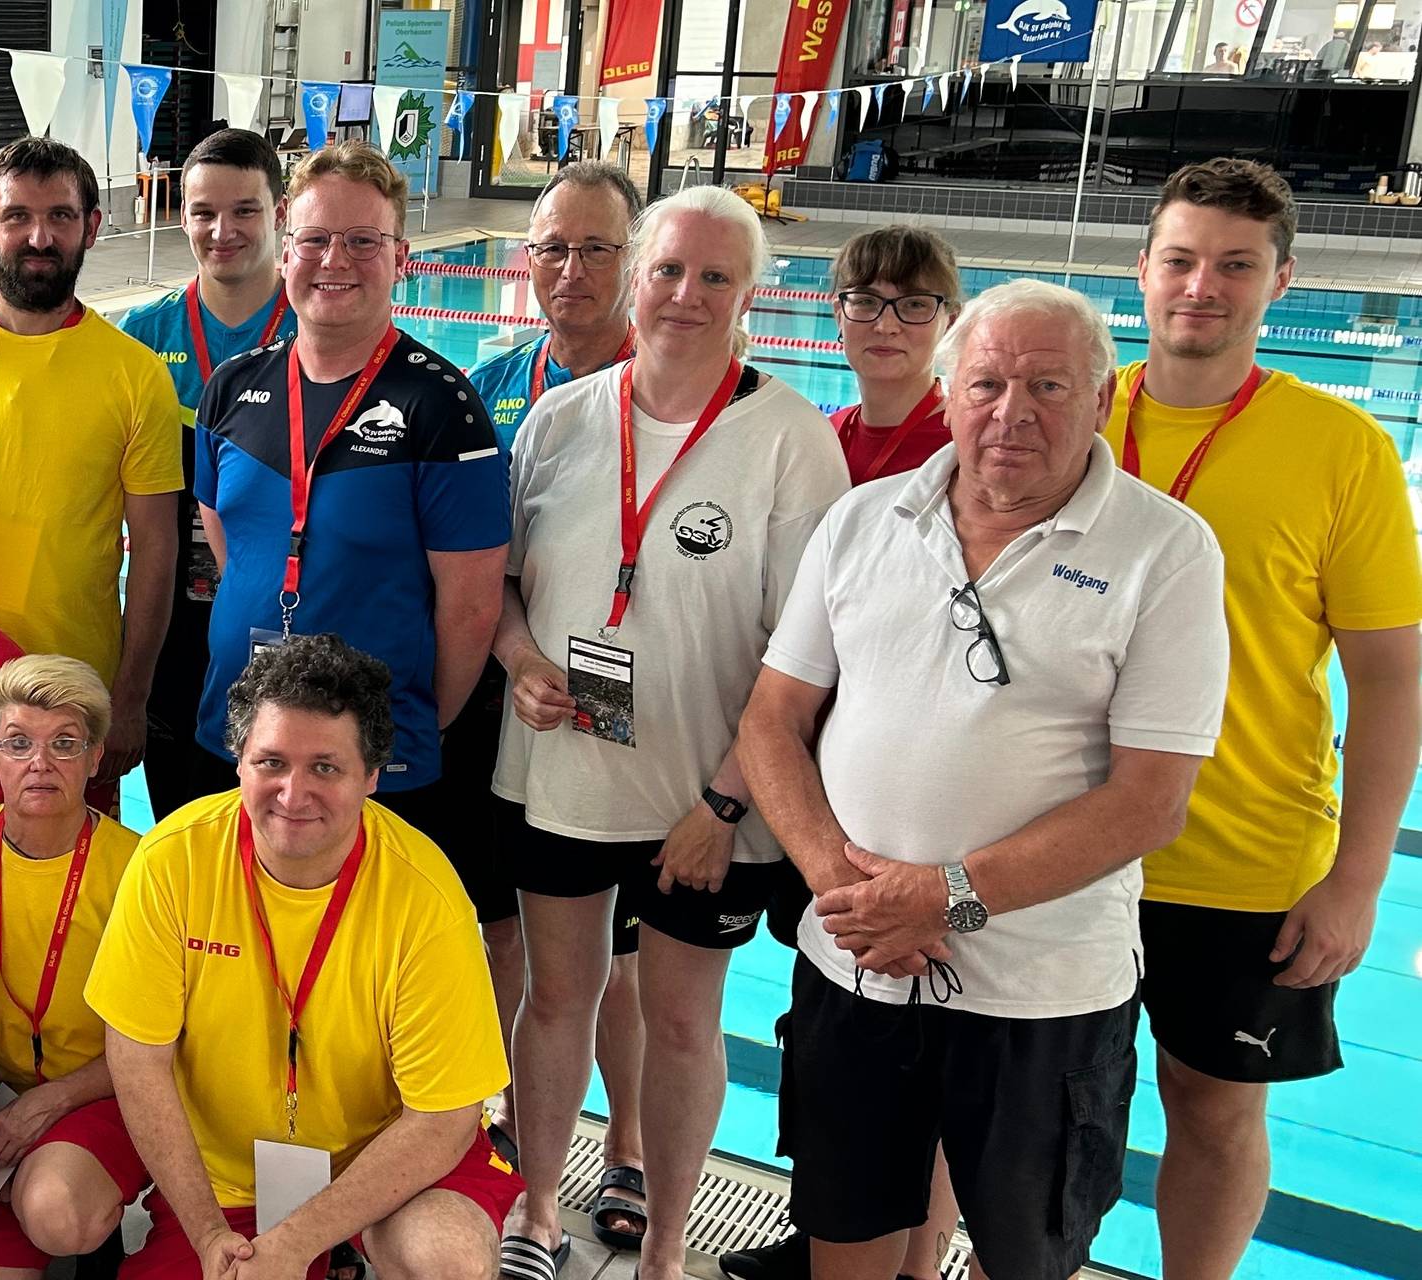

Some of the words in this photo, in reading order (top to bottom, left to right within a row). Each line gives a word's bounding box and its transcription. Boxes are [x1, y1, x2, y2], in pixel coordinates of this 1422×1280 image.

[603, 61, 651, 79] DLRG
[494, 398, 526, 411] JAKO
[350, 444, 388, 456] ALEXANDER
[1053, 563, 1109, 594] Wolfgang
[187, 938, 241, 958] DRG
